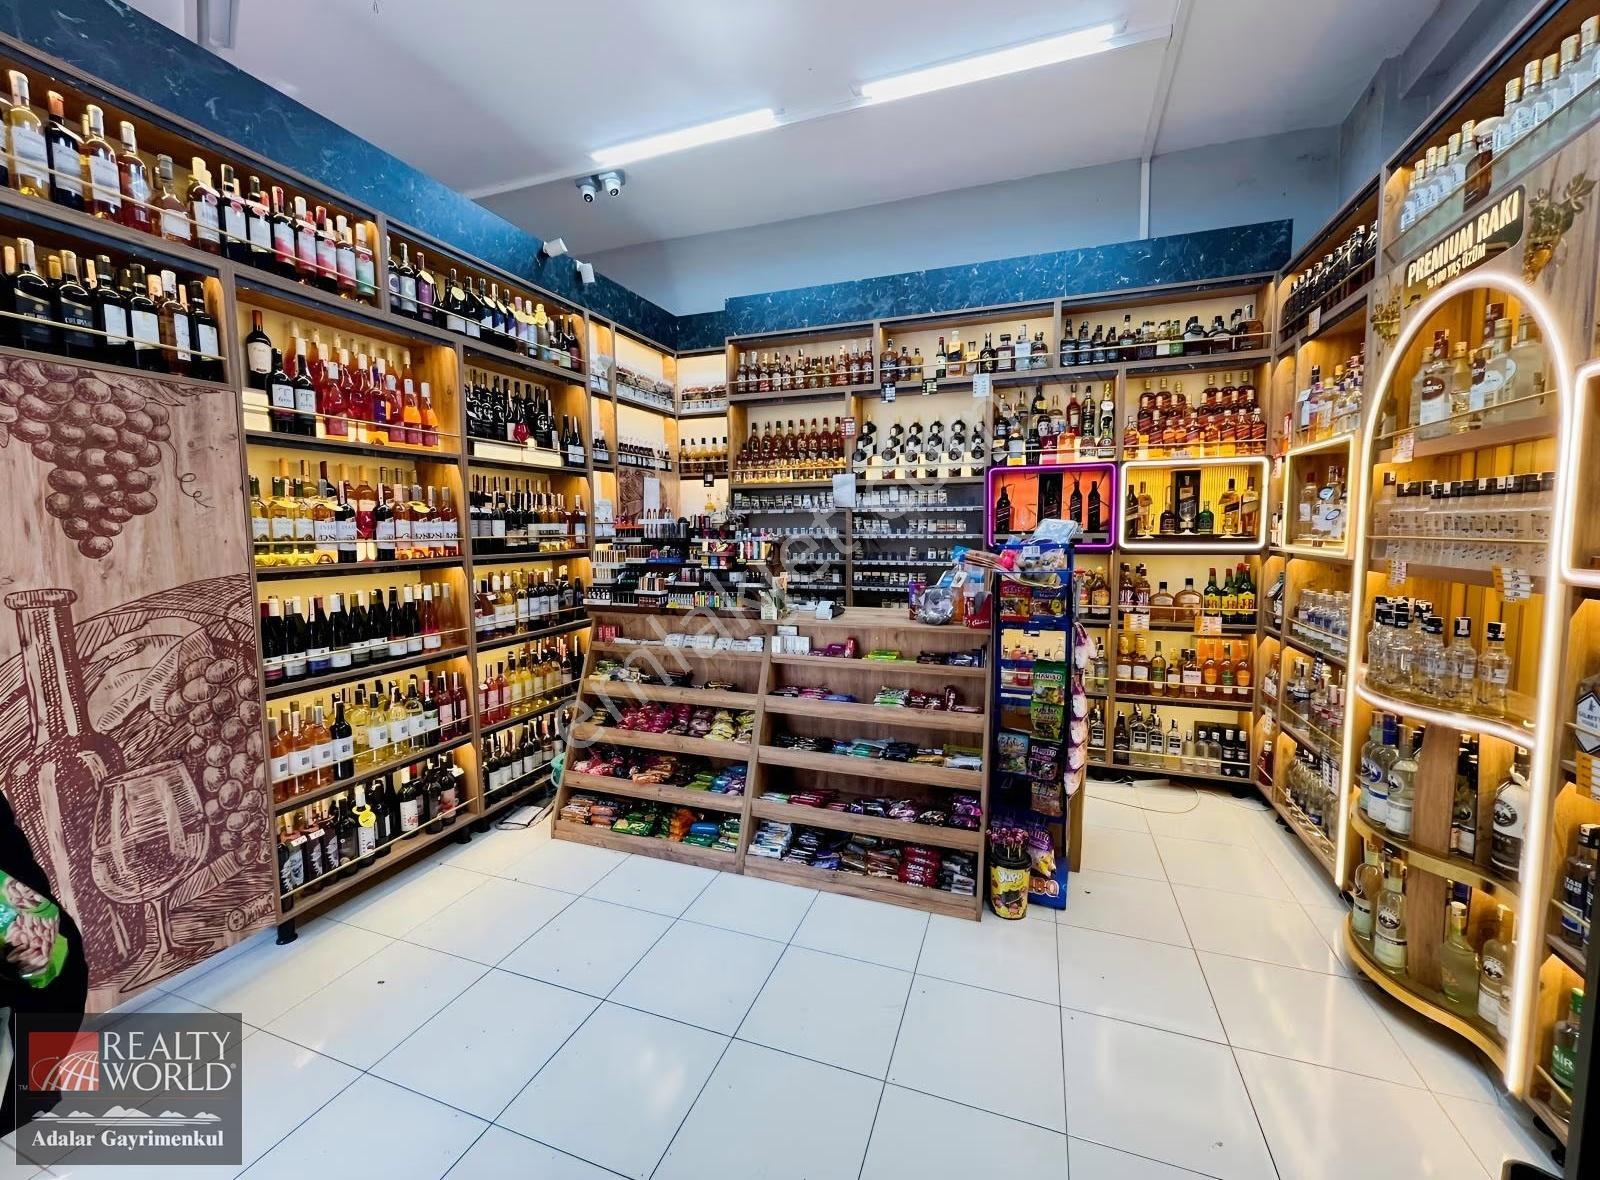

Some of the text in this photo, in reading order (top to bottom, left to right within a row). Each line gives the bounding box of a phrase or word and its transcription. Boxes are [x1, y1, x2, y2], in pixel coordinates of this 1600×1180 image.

[1407, 190, 1520, 288] PREMIUM RAKI
[1447, 257, 1462, 278] YAŞ
[1461, 242, 1487, 269] ÜZÜM
